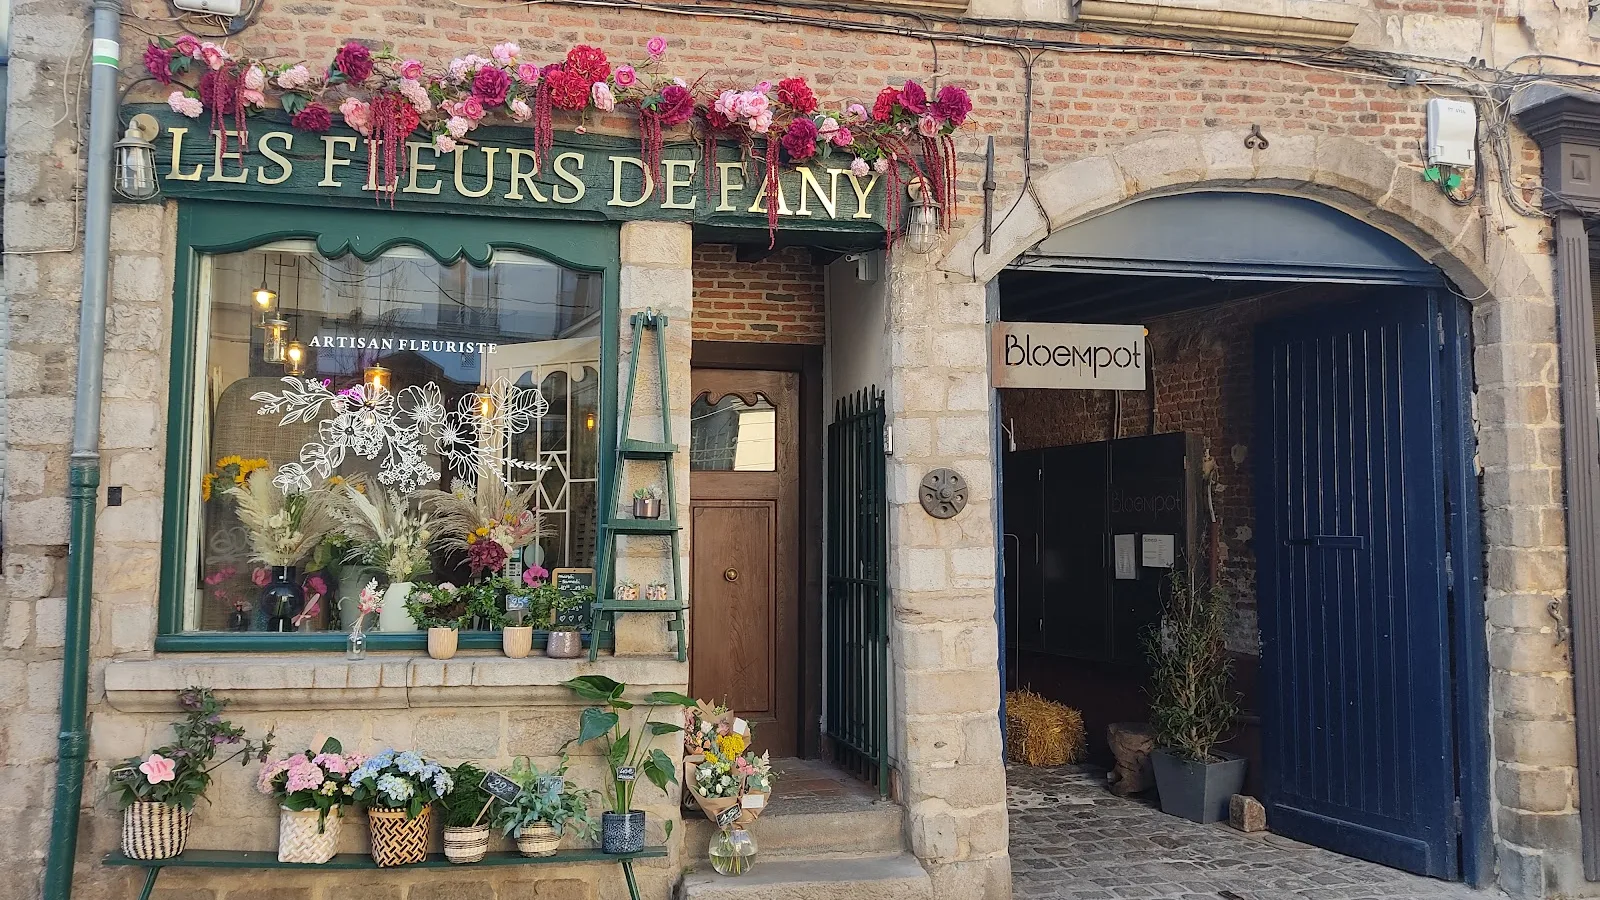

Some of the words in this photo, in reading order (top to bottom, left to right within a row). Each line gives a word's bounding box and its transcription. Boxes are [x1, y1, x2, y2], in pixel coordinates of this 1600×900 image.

[165, 128, 294, 185] LES
[317, 135, 586, 204] FLEURS
[607, 155, 698, 209] DE
[716, 162, 882, 220] FANY
[308, 335, 395, 350] ARTISAN
[398, 339, 499, 354] FLEURISTE
[1004, 333, 1142, 379] Bloempot
